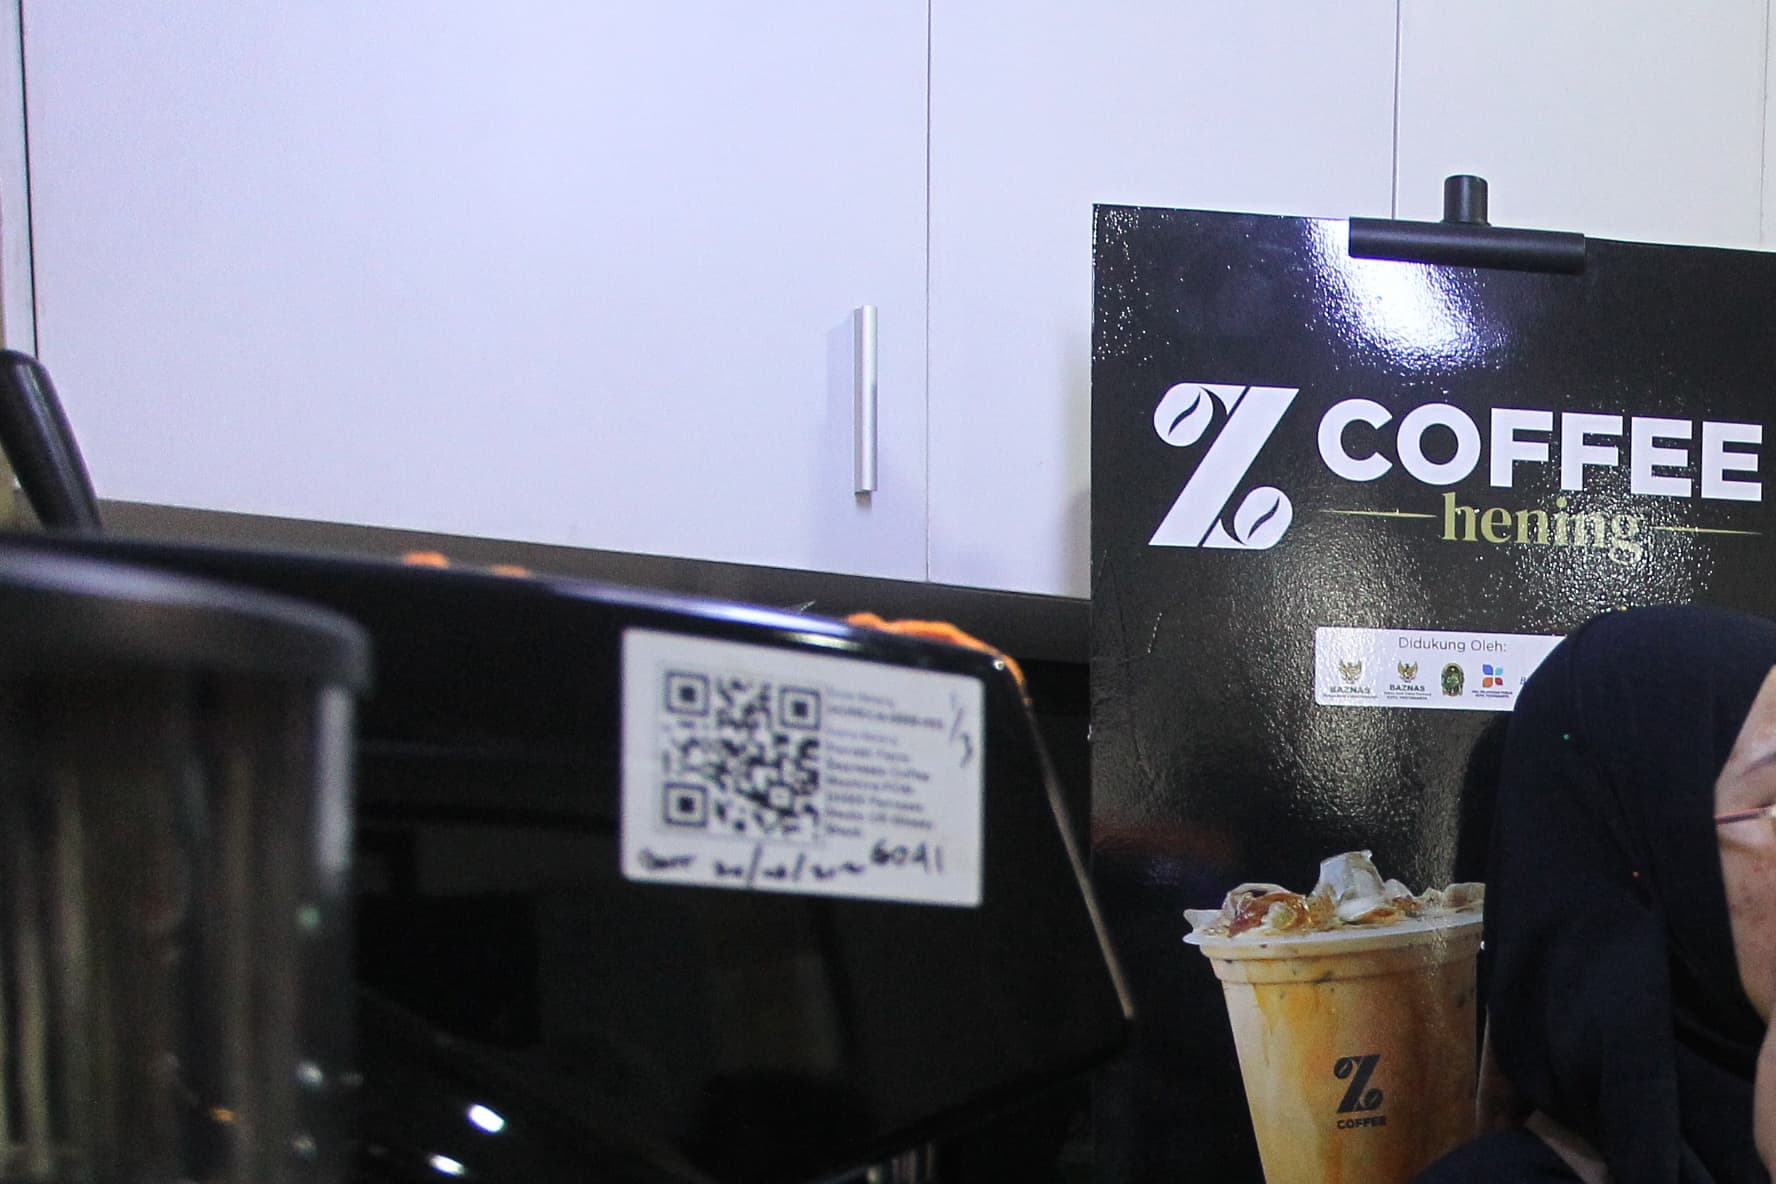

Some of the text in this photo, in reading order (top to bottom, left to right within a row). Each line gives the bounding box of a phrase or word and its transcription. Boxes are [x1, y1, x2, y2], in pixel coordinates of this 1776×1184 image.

[1316, 397, 1764, 503] COFFEE
[1440, 491, 1646, 564] hening
[1398, 637, 1506, 652] Didukung Oleh:
[1336, 1116, 1386, 1129] COFFEE
